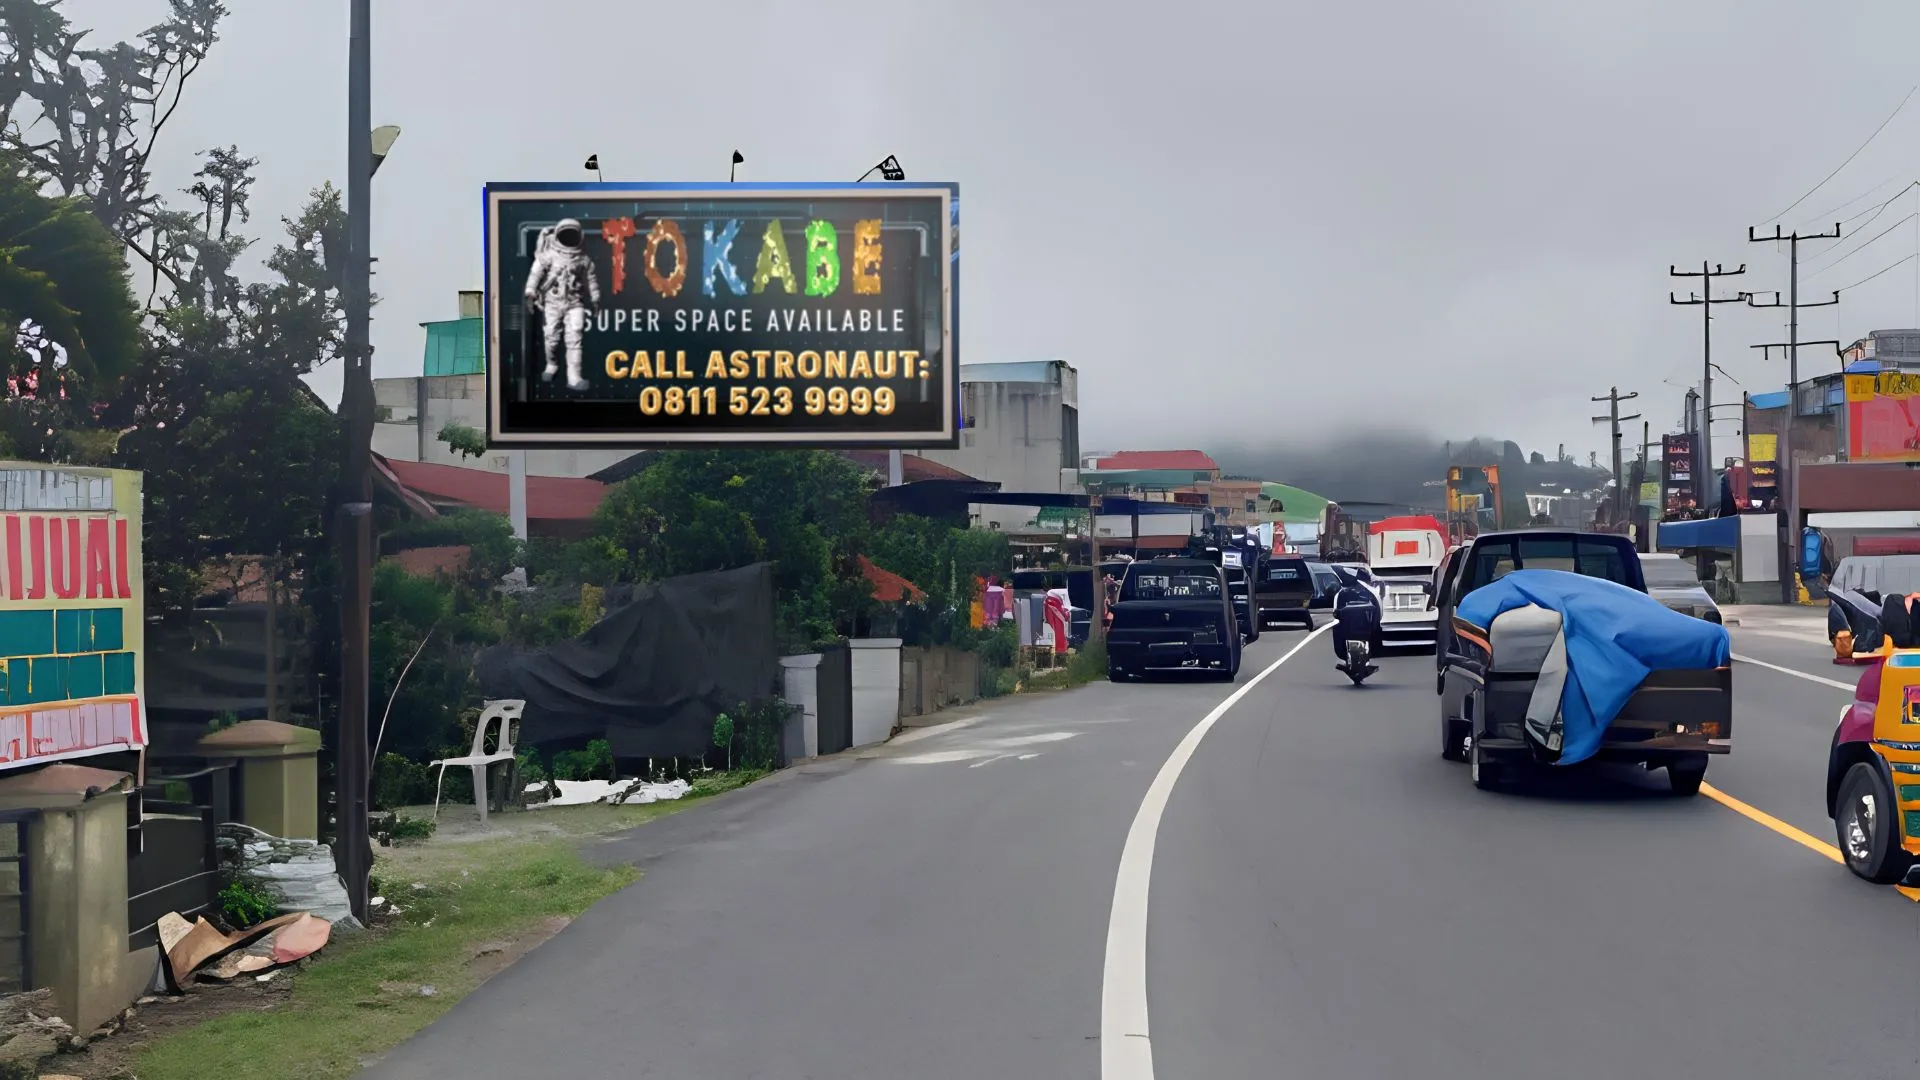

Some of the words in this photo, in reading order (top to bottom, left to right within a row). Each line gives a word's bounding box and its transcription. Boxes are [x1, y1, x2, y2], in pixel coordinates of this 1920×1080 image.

[602, 217, 882, 297] TOKABE
[583, 308, 660, 332] SUPER
[675, 308, 753, 332] SPACE
[767, 308, 905, 332] AVAILABLE
[605, 350, 694, 379] CALL
[705, 350, 930, 379] ASTRONAUT:
[639, 387, 717, 415] 0811
[728, 387, 793, 415] 523
[804, 387, 896, 415] 9999
